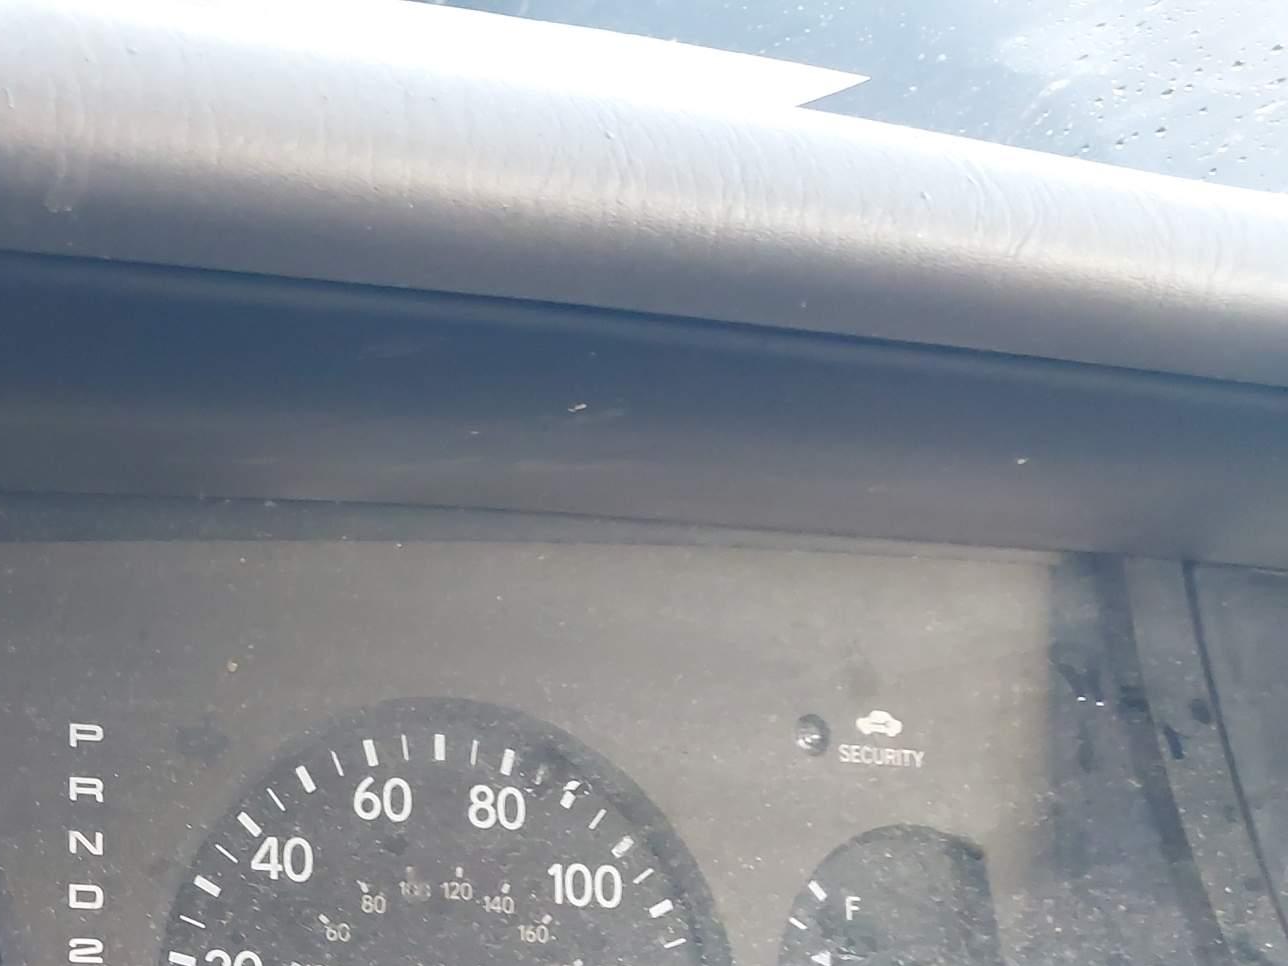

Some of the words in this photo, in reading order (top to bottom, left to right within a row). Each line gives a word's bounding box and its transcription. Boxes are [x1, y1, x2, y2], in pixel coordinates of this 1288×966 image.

[68, 723, 104, 747] P
[838, 743, 925, 768] SECURITY
[68, 777, 104, 802] R
[353, 777, 413, 822] 60
[468, 785, 526, 830] 80
[68, 831, 104, 856] N
[250, 836, 313, 882] 40
[68, 884, 104, 909] D
[440, 881, 473, 900] 120
[547, 863, 623, 909] 100
[360, 895, 387, 914] 80
[483, 896, 515, 914] 140
[844, 896, 862, 921] F
[325, 923, 351, 943] 60
[519, 925, 549, 944] 160
[68, 938, 104, 963] 2
